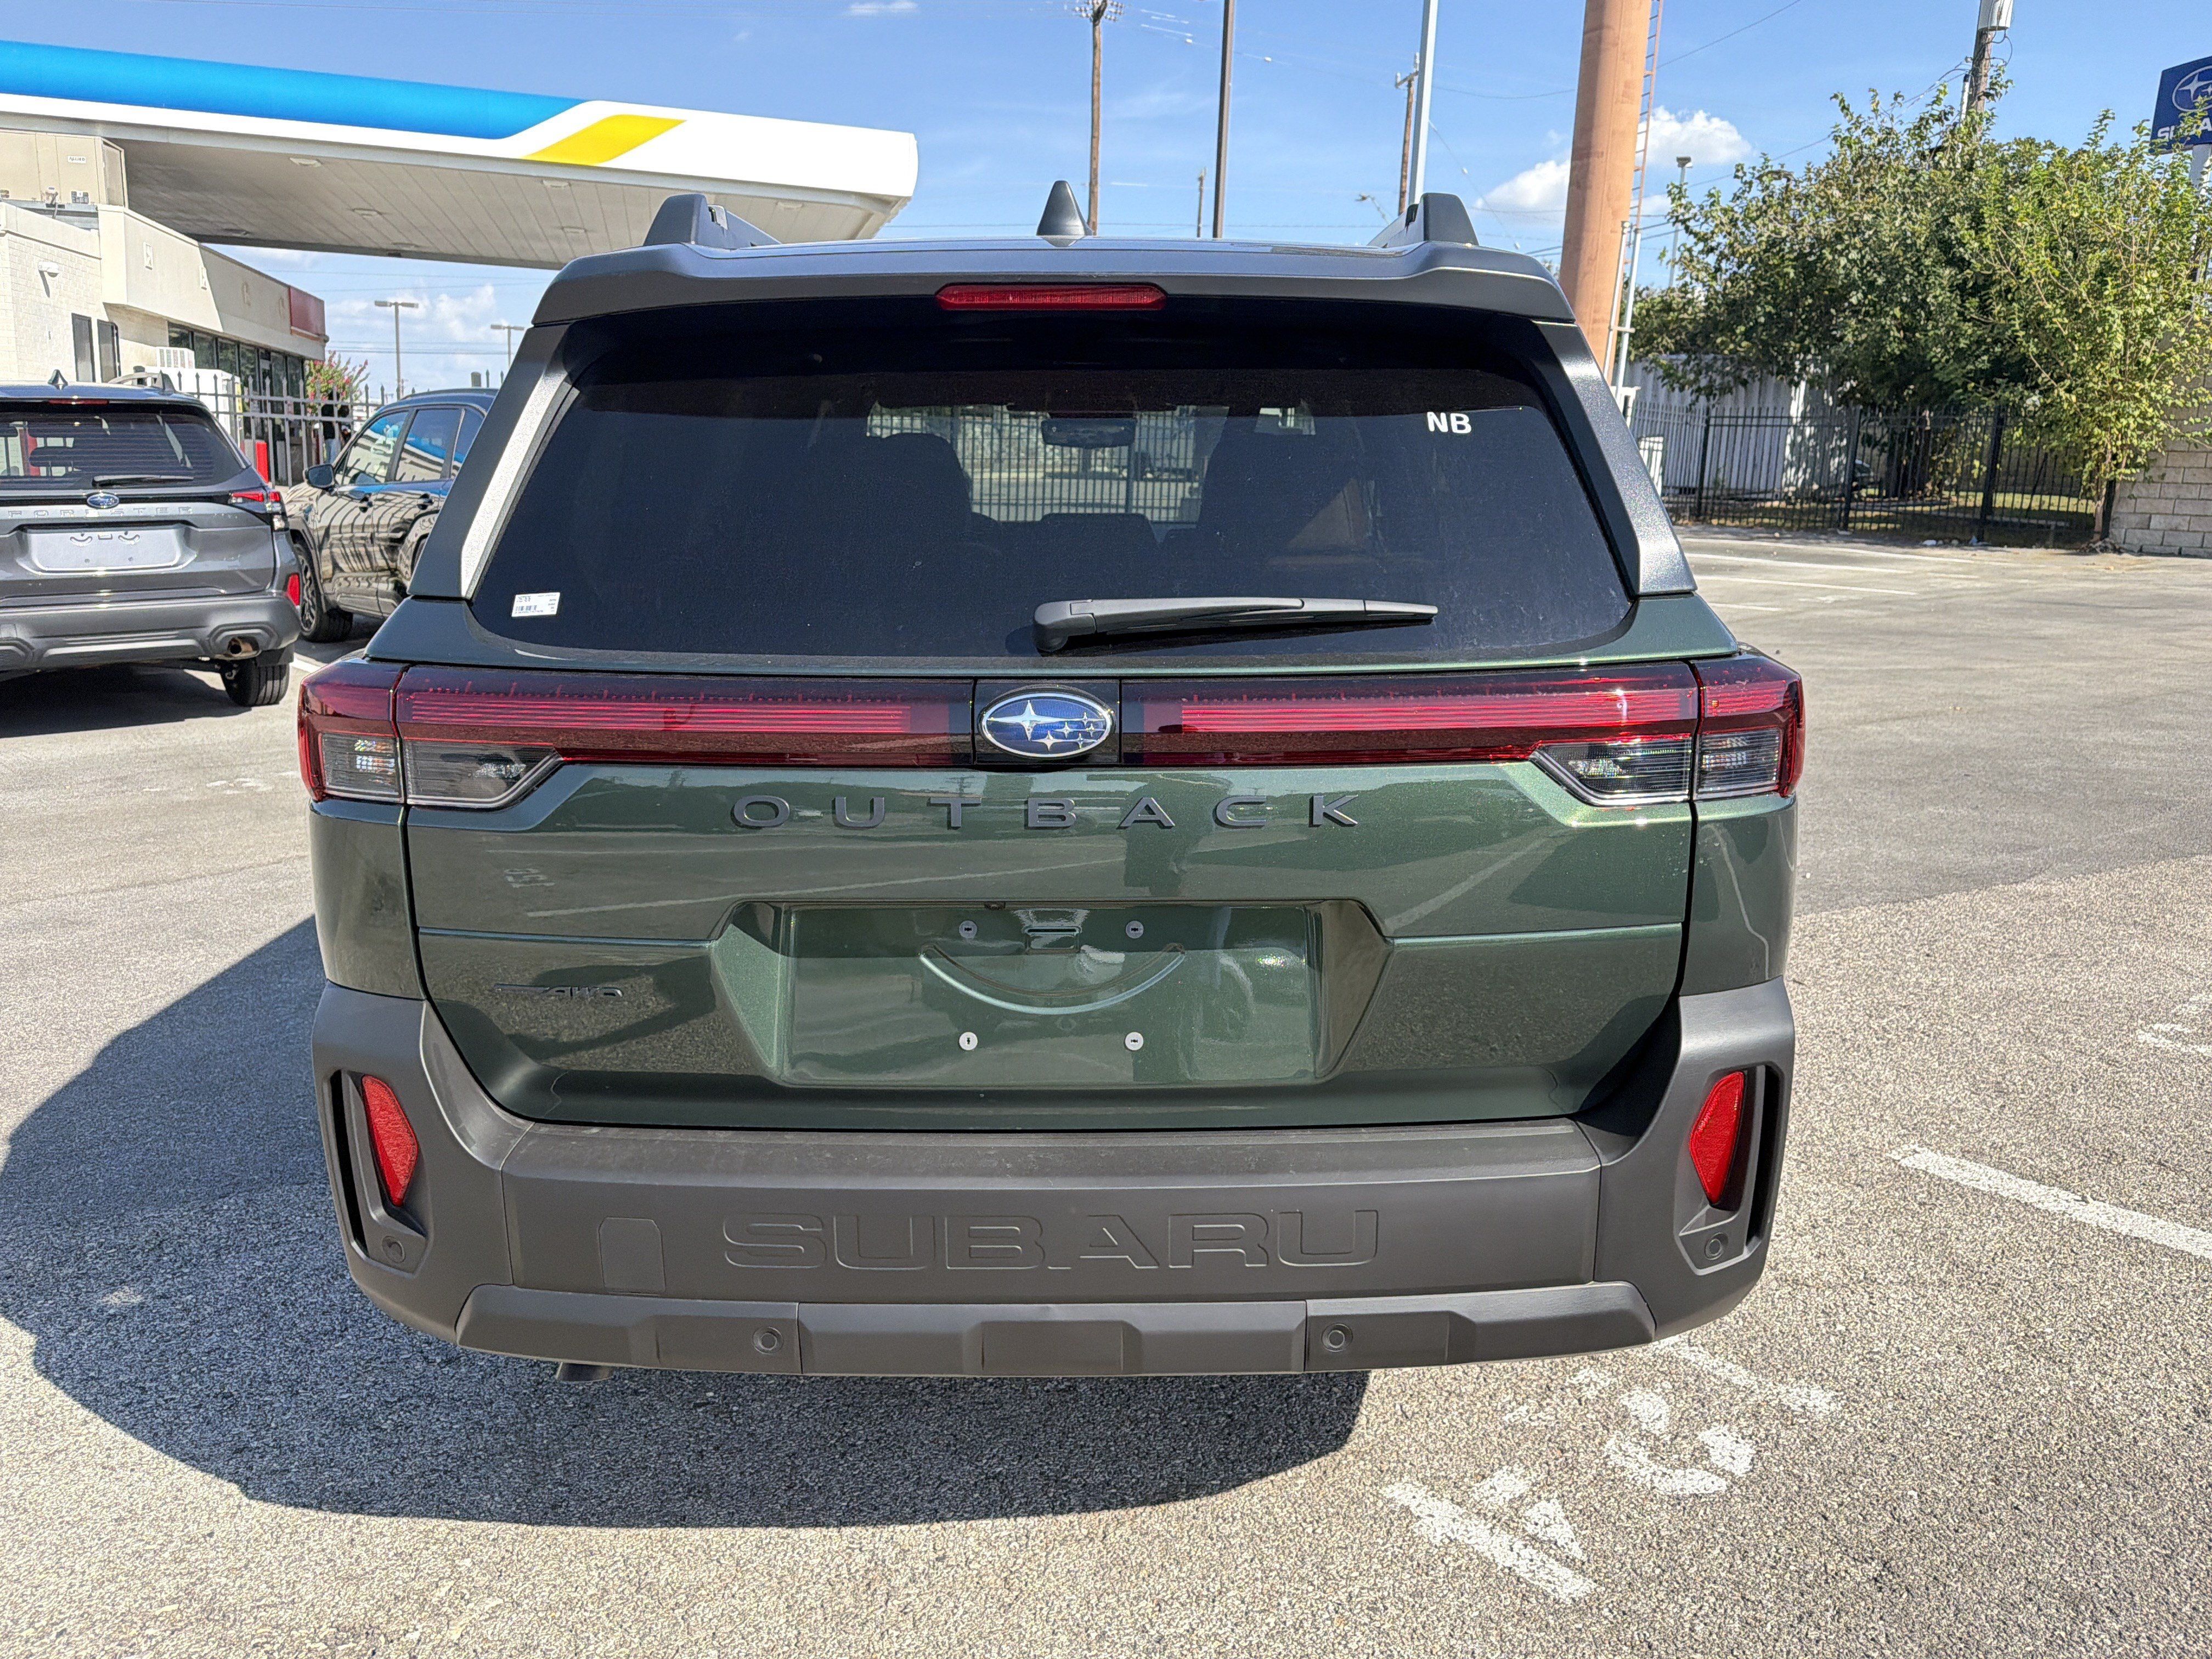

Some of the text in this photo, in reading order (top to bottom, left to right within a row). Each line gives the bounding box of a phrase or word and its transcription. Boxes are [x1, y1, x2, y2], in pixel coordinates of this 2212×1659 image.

[2158, 117, 2212, 141] SUA
[1427, 411, 1471, 433] NB
[731, 794, 1358, 828] OUTBACK
[723, 1210, 1379, 1270] SUBARU
